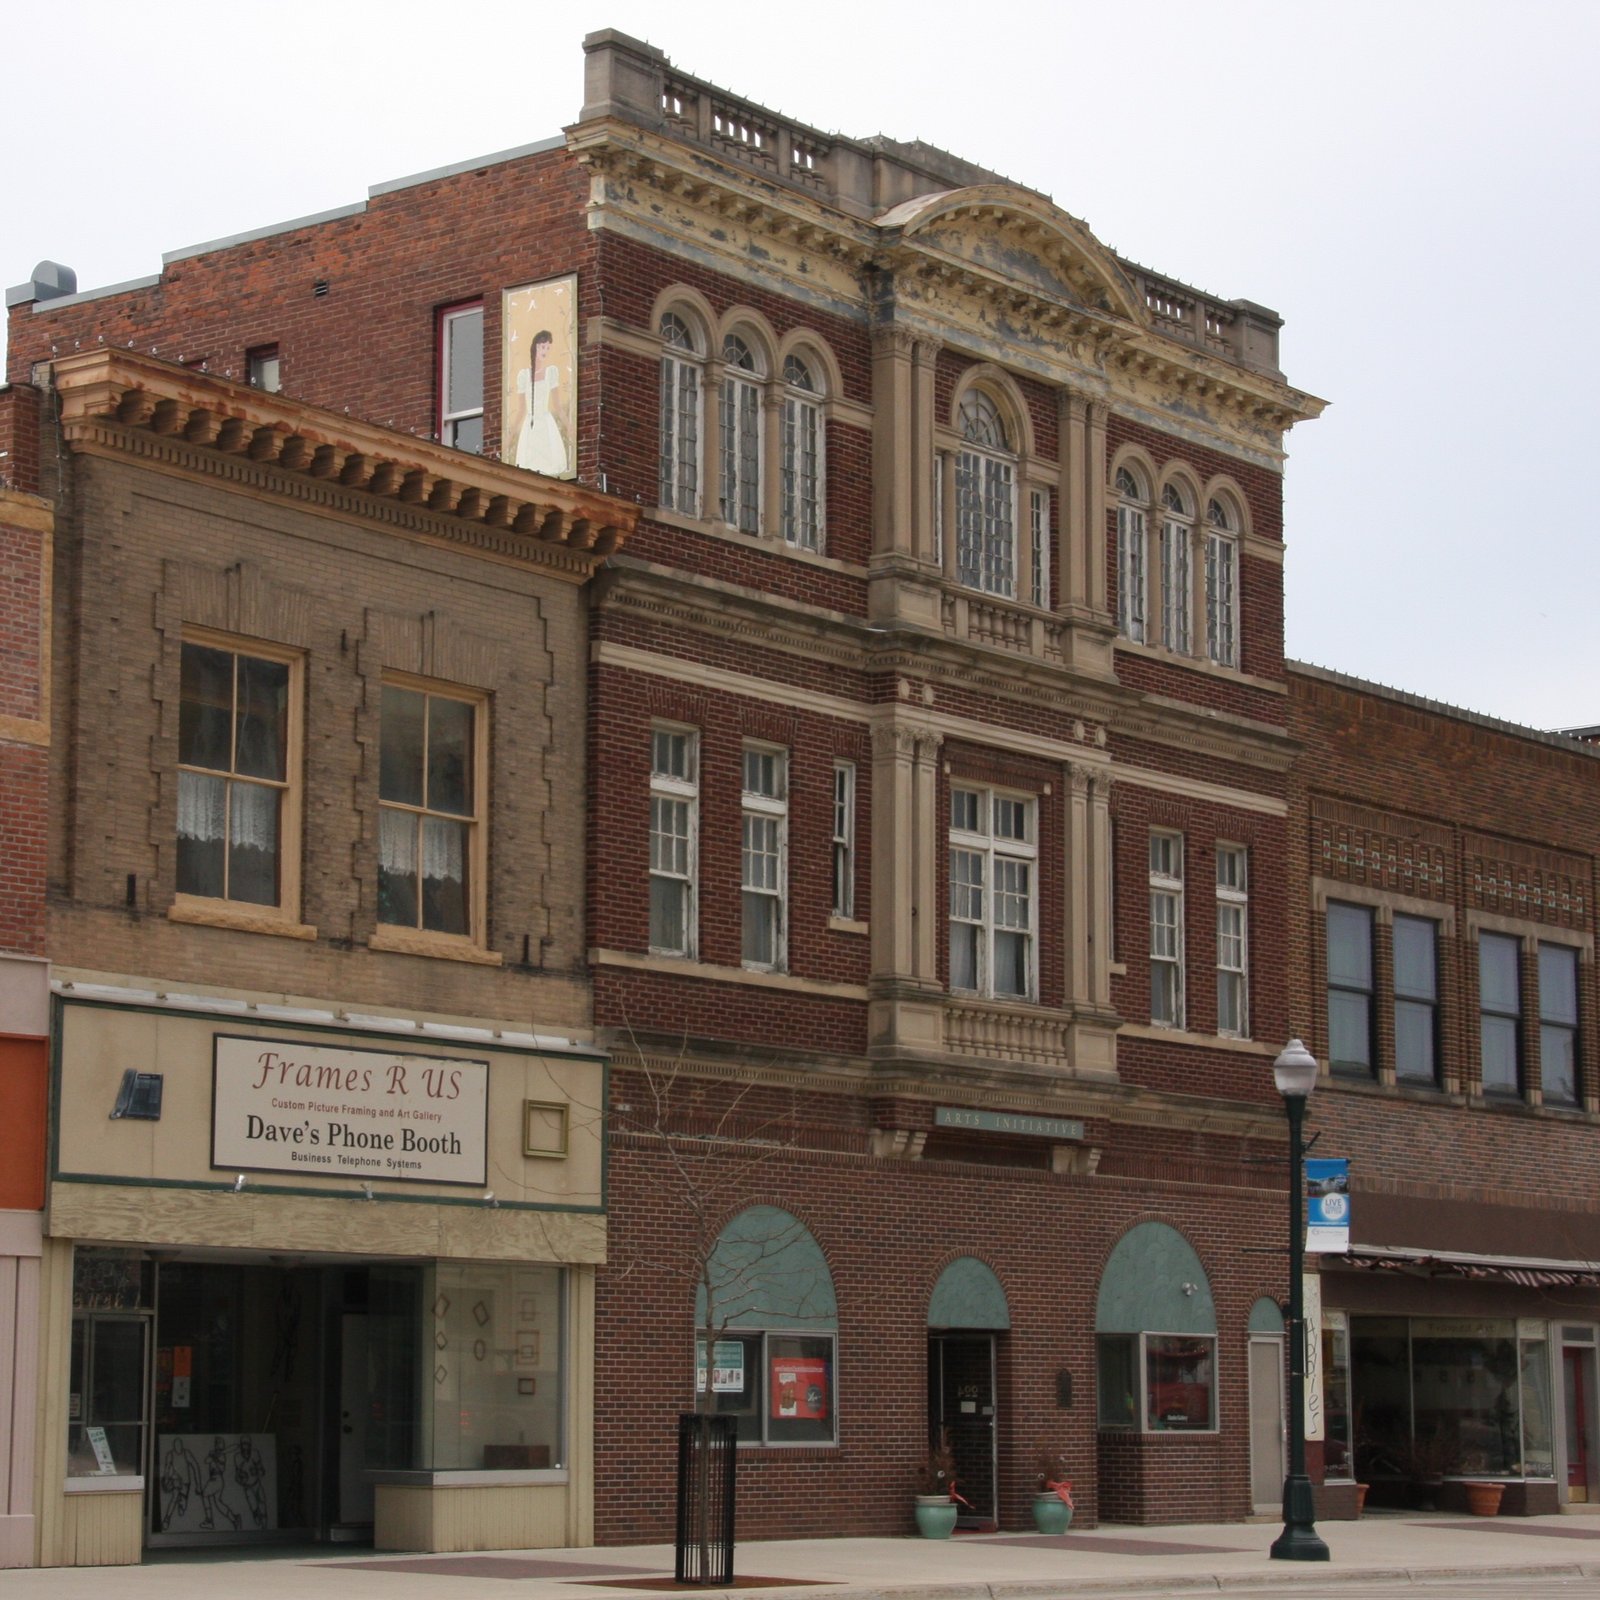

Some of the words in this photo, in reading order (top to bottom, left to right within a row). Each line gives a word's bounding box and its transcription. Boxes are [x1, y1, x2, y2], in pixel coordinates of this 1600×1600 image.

[252, 1052, 372, 1092] Frames
[386, 1065, 409, 1095] R
[421, 1068, 462, 1100] US
[272, 1098, 305, 1110] Custom
[308, 1101, 339, 1113] Picture
[341, 1104, 376, 1118] Framing
[379, 1109, 394, 1118] and
[397, 1109, 410, 1119] Art
[413, 1110, 442, 1123] Gallery
[246, 1114, 320, 1145] Dave's
[327, 1122, 394, 1150] Phone
[401, 1128, 462, 1155] Booth
[945, 1112, 979, 1126] ARTS
[996, 1116, 1077, 1135] INITIATIVE
[291, 1151, 331, 1163] Business
[337, 1154, 381, 1167] Telephone
[386, 1157, 422, 1169] Systems
[1325, 1198, 1342, 1207] LIVE
